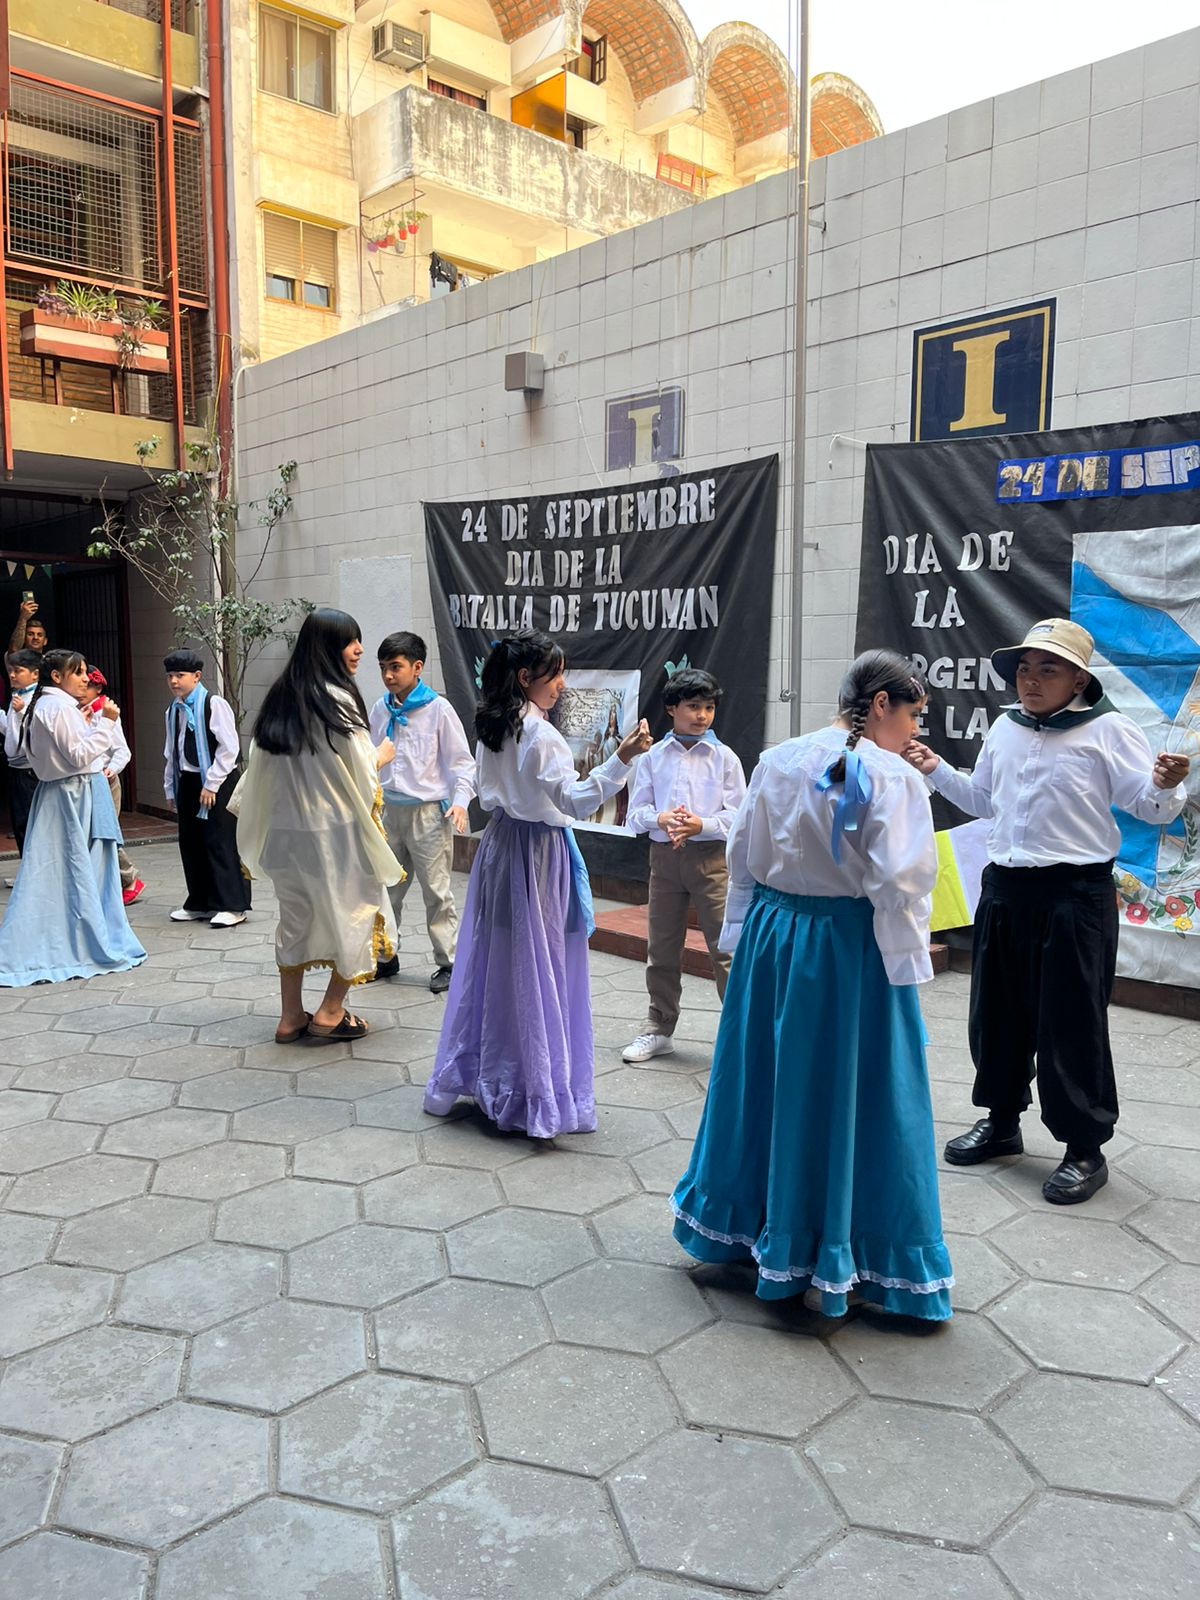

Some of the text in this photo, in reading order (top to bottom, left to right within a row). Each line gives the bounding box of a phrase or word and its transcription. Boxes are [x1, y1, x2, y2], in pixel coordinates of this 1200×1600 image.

[948, 329, 1010, 431] I
[998, 445, 1200, 498] 24 DE SEP
[461, 478, 717, 543] 24 DE SEPTIEMBRE
[505, 545, 623, 588] DIA DE LA
[883, 530, 1014, 575] DIA DE
[449, 585, 719, 632] BATALLA DE TUCUMAN
[911, 585, 965, 629] LA
[905, 652, 1007, 691] RGEN
[915, 705, 990, 741] E LA
